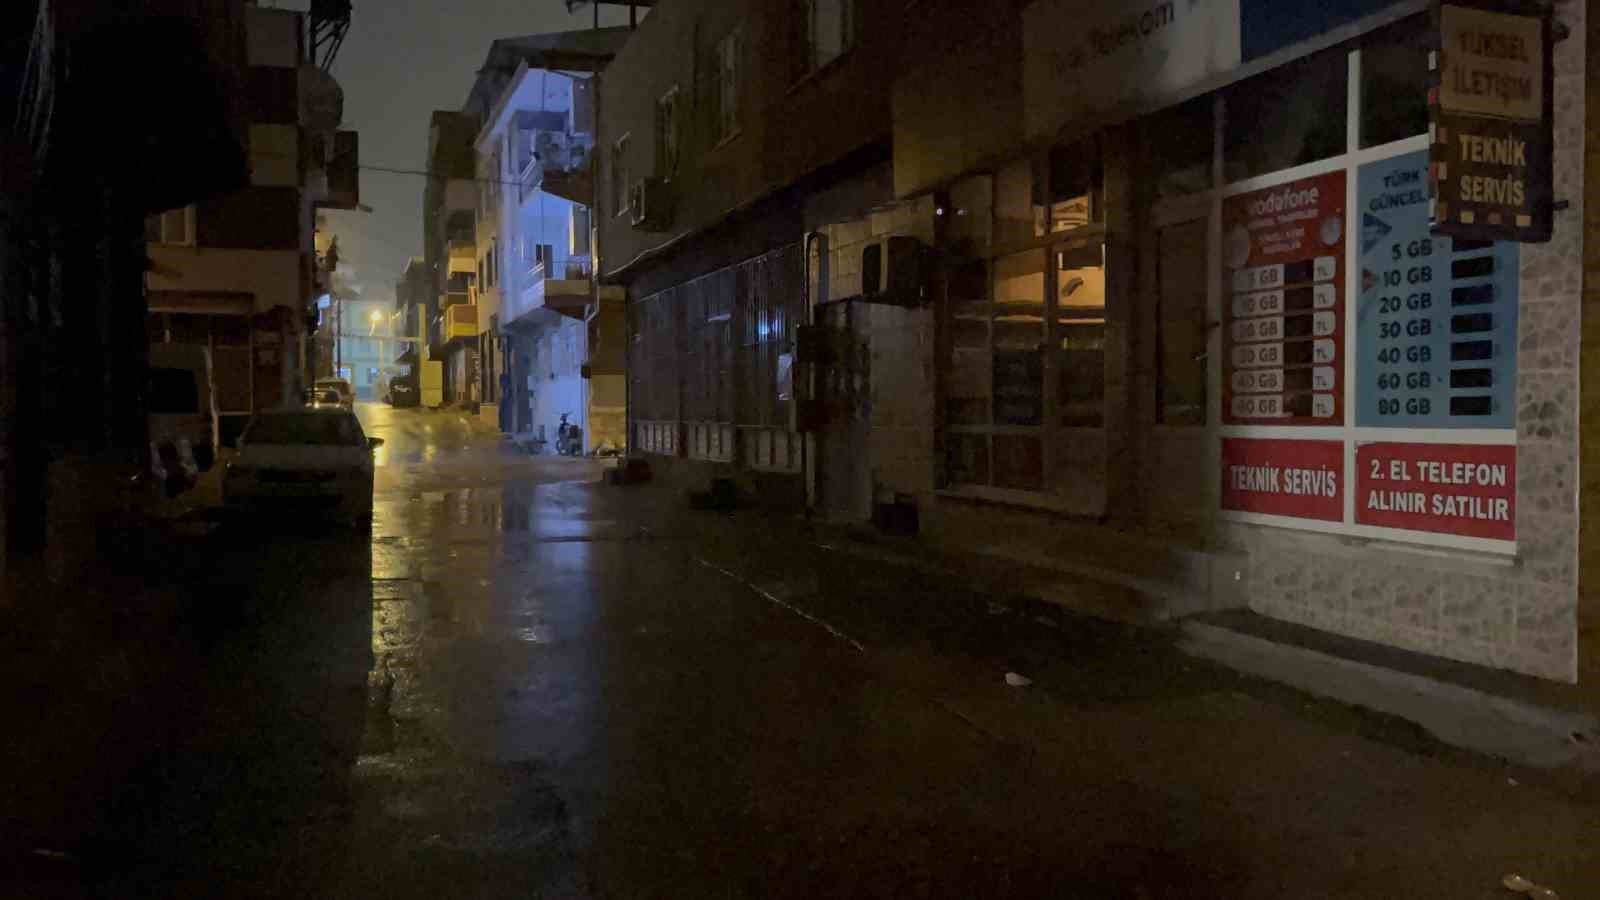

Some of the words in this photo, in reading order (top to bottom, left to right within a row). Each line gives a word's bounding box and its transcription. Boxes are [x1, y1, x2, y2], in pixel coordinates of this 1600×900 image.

[1457, 131, 1527, 166] TEKNİK
[1384, 169, 1420, 188] TÜRK
[1460, 173, 1525, 207] SERVİS
[1369, 190, 1426, 212] GÜNCEL
[1392, 243, 1402, 261] 5
[1407, 238, 1433, 258] GB
[1260, 268, 1278, 284] GB
[1383, 269, 1401, 288] 10
[1407, 265, 1433, 285] GB
[1260, 294, 1278, 310] GB
[1379, 295, 1401, 315] 20
[1406, 291, 1432, 311] GB
[1259, 320, 1278, 337] GB
[1379, 322, 1401, 340] 30
[1406, 318, 1432, 338] GB
[1259, 346, 1278, 362] GB
[1378, 348, 1400, 366] 40
[1406, 345, 1431, 365] GB
[1259, 372, 1278, 389] GB
[1377, 373, 1400, 391] 60
[1406, 371, 1431, 391] GB
[1259, 398, 1277, 414] GB
[1378, 399, 1400, 416] 80
[1406, 397, 1431, 417] GB
[1230, 461, 1280, 494] TEKNİK
[1284, 464, 1337, 498] SERVİS
[1370, 459, 1385, 480] 2.
[1391, 462, 1412, 482] EL
[1417, 462, 1506, 487] TELEFON
[1368, 489, 1426, 514] ALINIR
[1432, 493, 1509, 521] SATILIR
